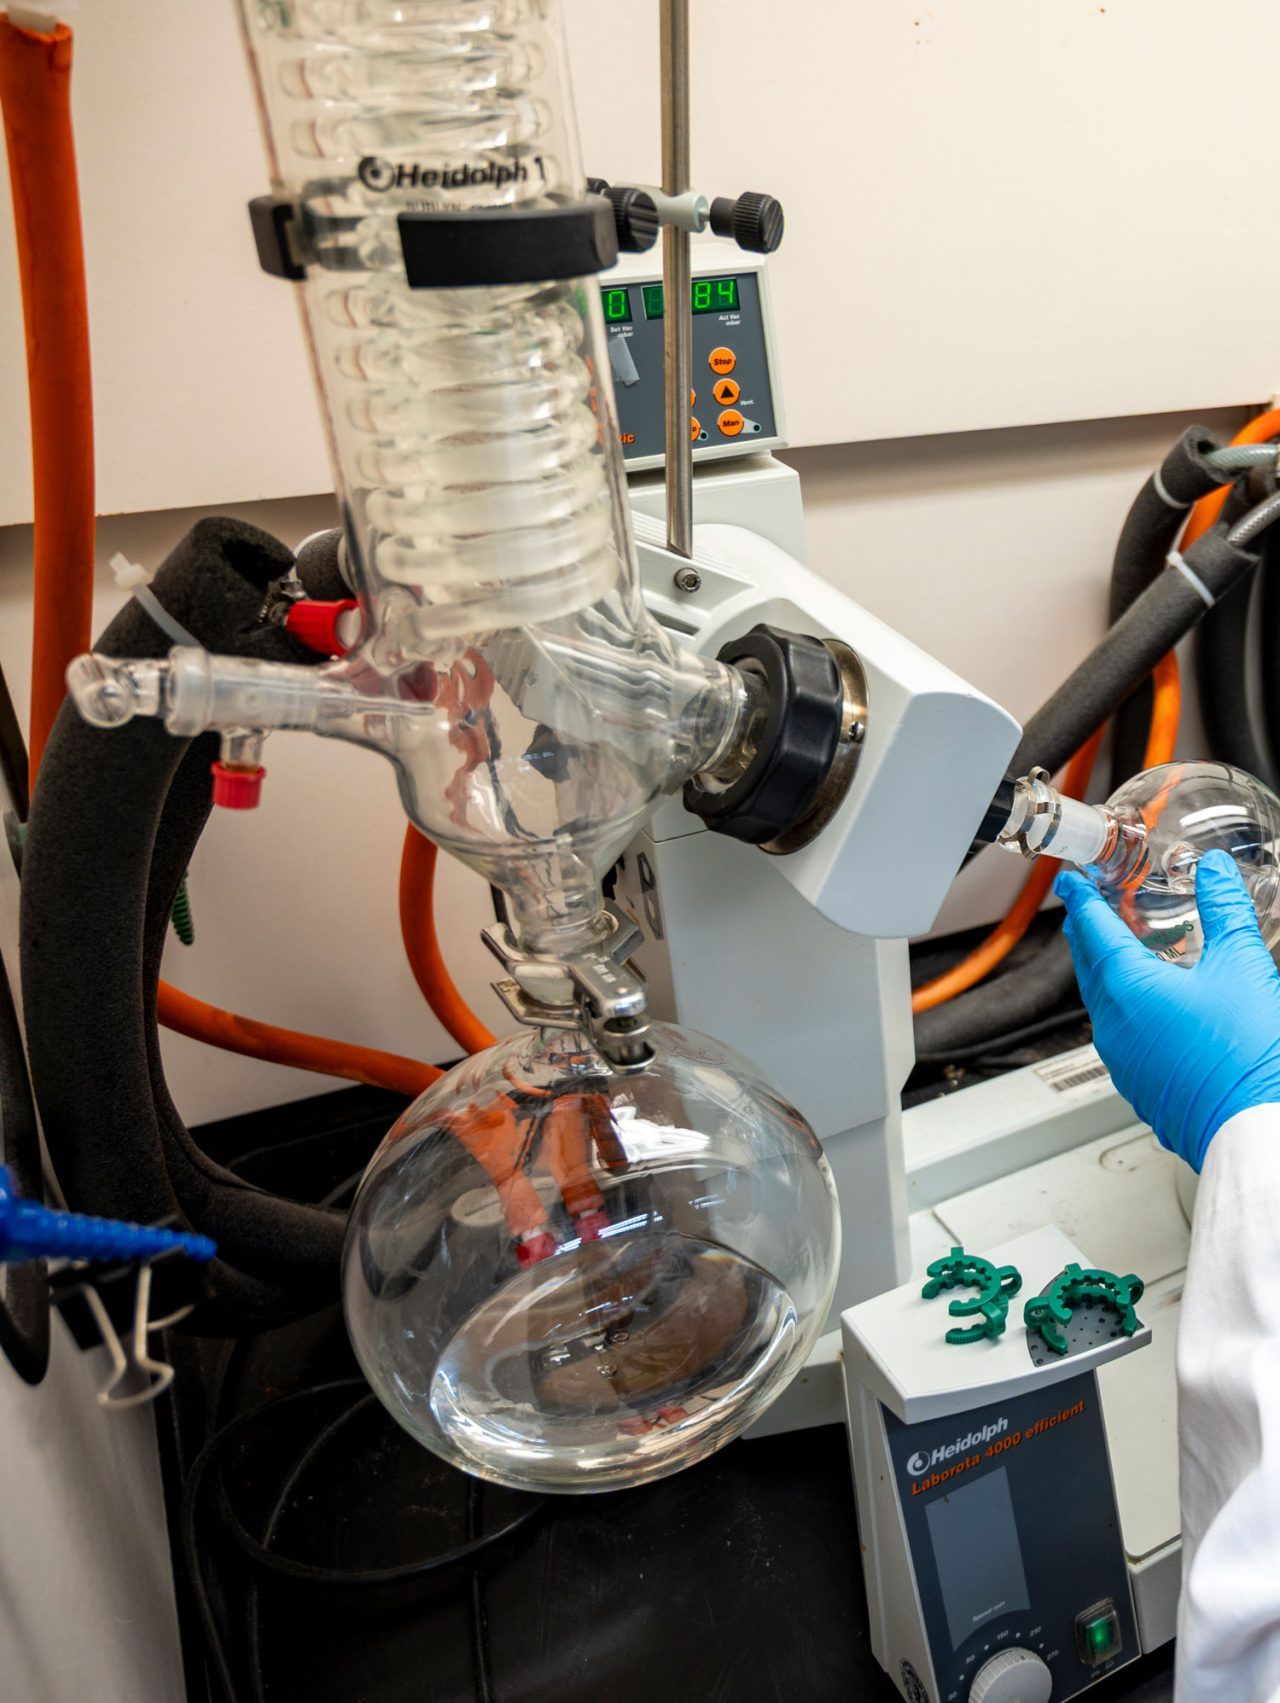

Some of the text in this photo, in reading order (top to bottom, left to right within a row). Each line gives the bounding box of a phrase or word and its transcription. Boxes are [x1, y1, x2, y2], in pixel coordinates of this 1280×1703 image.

[396, 157, 528, 190] Heidolph
[695, 280, 734, 309] 84
[713, 358, 732, 366] Stop
[722, 419, 740, 427] Man
[1164, 947, 1186, 960] ML
[911, 1399, 1086, 1496] Laborota 4000 efficient
[930, 1416, 1009, 1467] Heidolph
